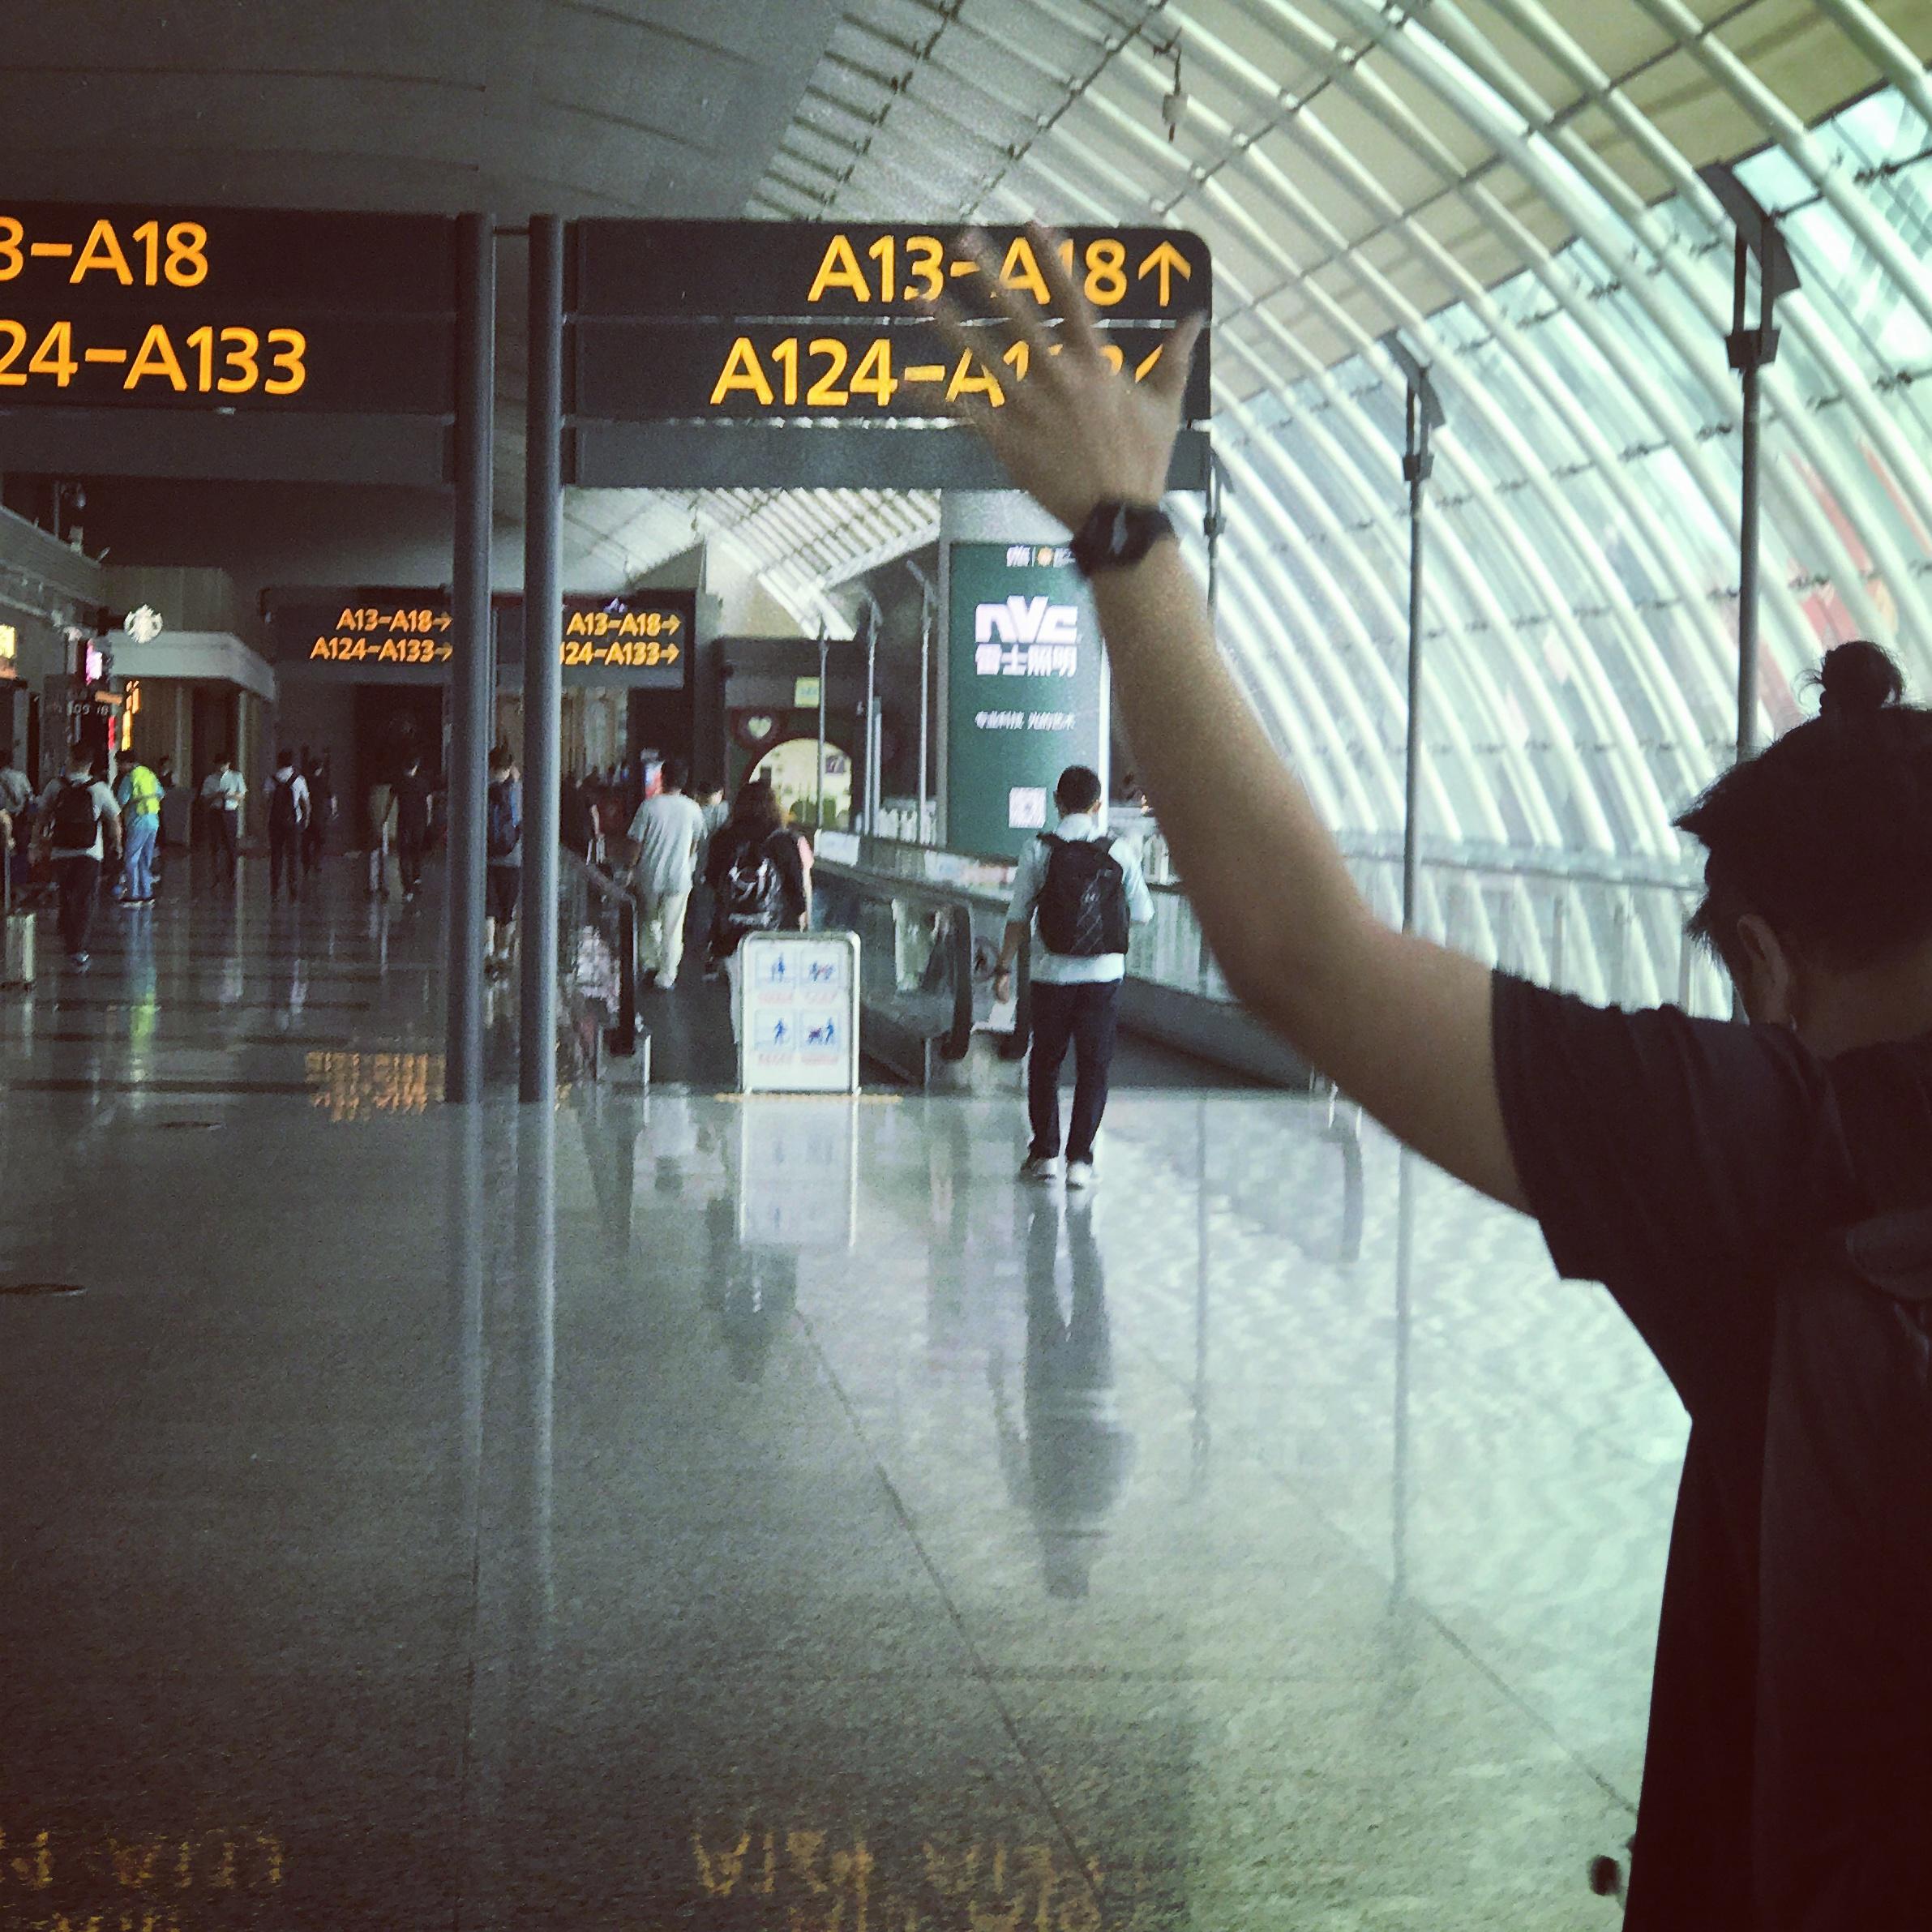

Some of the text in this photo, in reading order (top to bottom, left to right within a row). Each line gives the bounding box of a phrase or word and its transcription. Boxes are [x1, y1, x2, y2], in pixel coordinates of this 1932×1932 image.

[709, 336, 1125, 408] A124-A1
[335, 608, 433, 633] A13-A18
[566, 611, 662, 636] A13-A18
[310, 636, 435, 662] A124-A133
